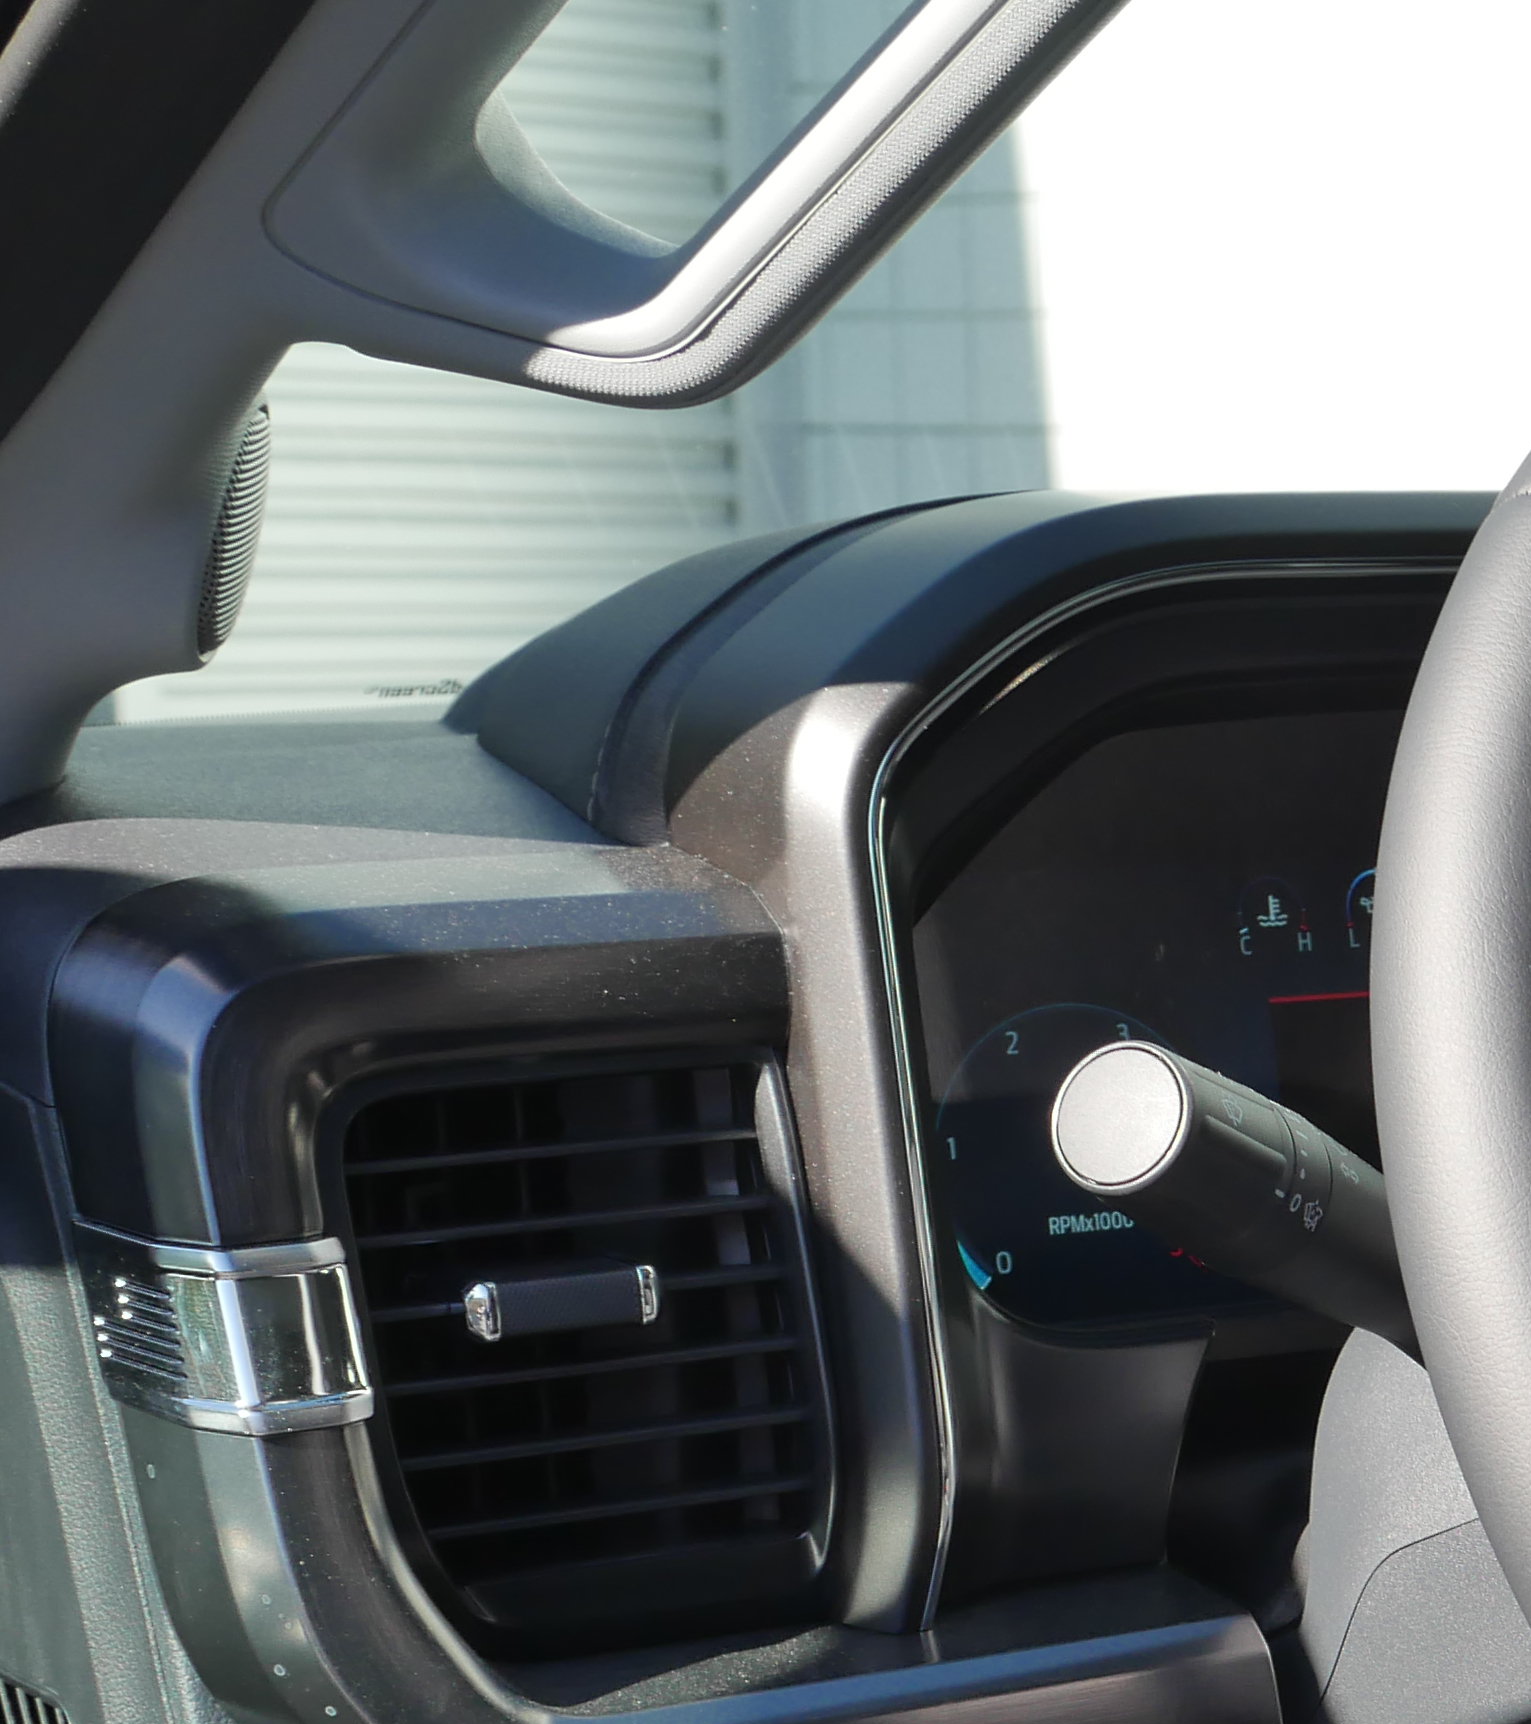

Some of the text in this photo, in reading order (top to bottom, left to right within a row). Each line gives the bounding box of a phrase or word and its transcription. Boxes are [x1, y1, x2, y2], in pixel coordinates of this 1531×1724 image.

[1240, 935, 1252, 955] C
[1298, 931, 1312, 951] H
[1005, 1031, 1019, 1055] 2
[946, 1136, 956, 1160] 1
[995, 1251, 1013, 1275] 0
